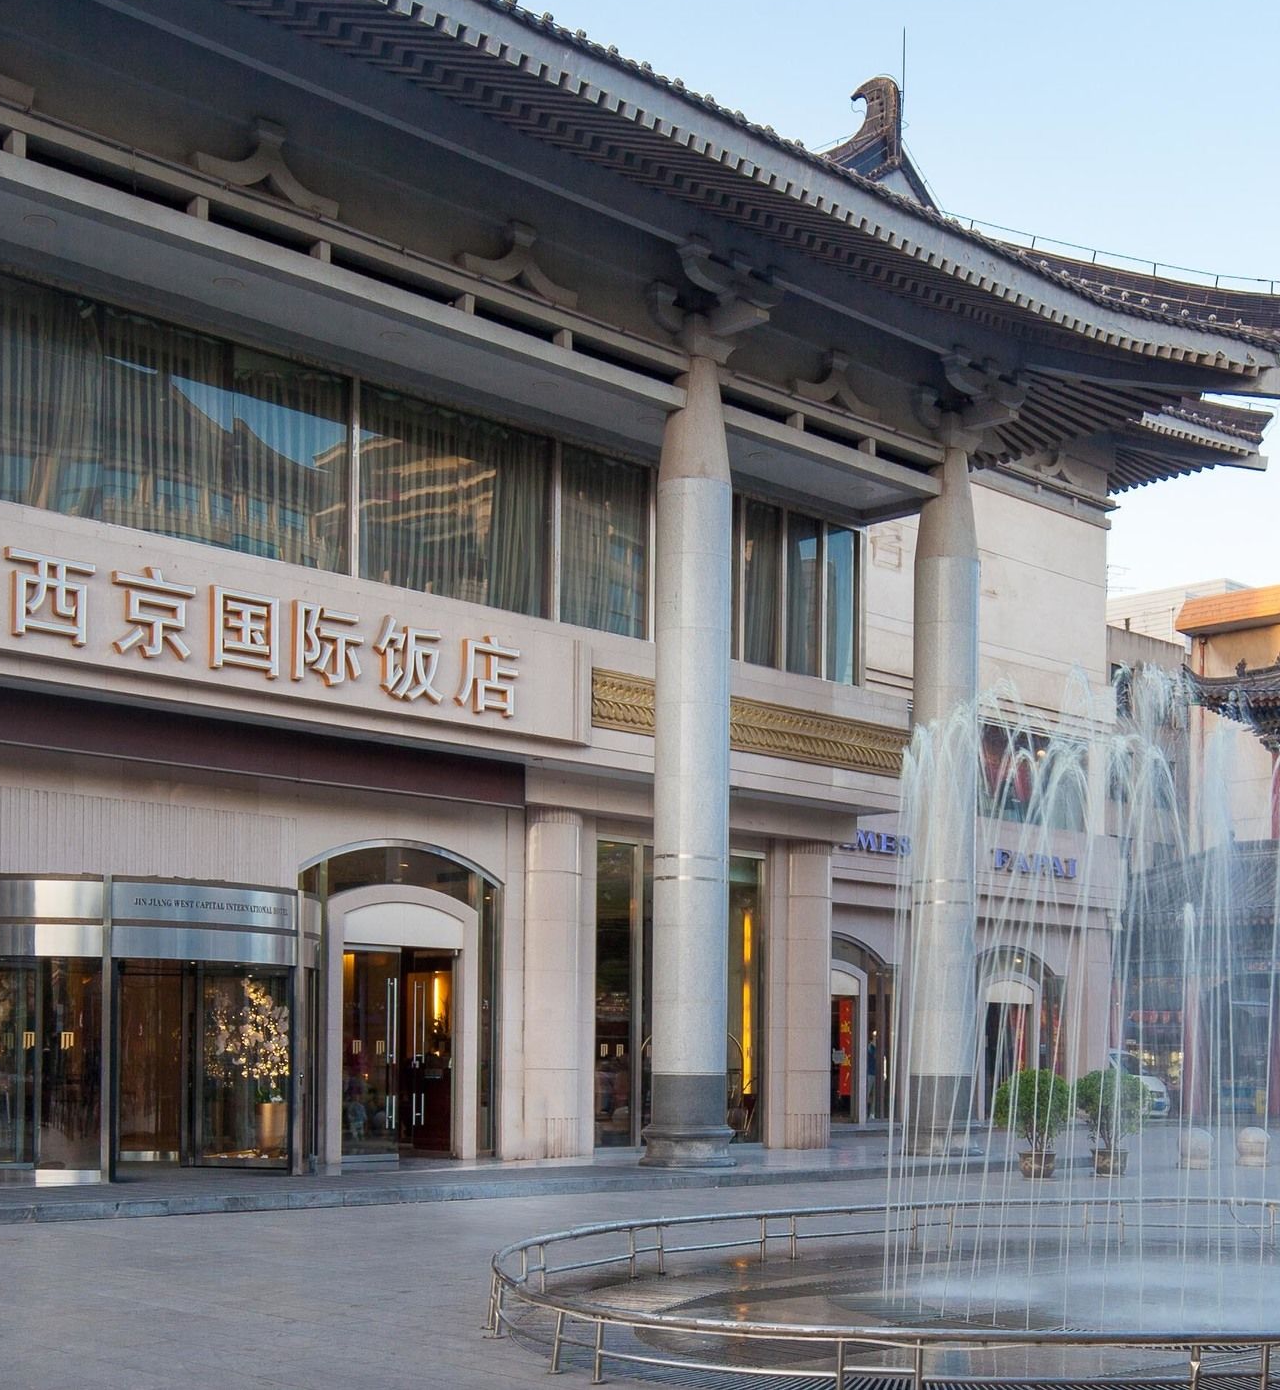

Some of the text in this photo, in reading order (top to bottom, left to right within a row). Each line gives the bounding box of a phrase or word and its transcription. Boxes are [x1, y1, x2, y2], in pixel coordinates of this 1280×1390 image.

[992, 848, 1077, 878] FAPAI
[134, 897, 147, 906] JIN
[148, 898, 172, 907] JIANG
[173, 899, 195, 908] WEST
[195, 901, 225, 910] CAPITAL
[226, 903, 272, 915] INTERNATIONAL
